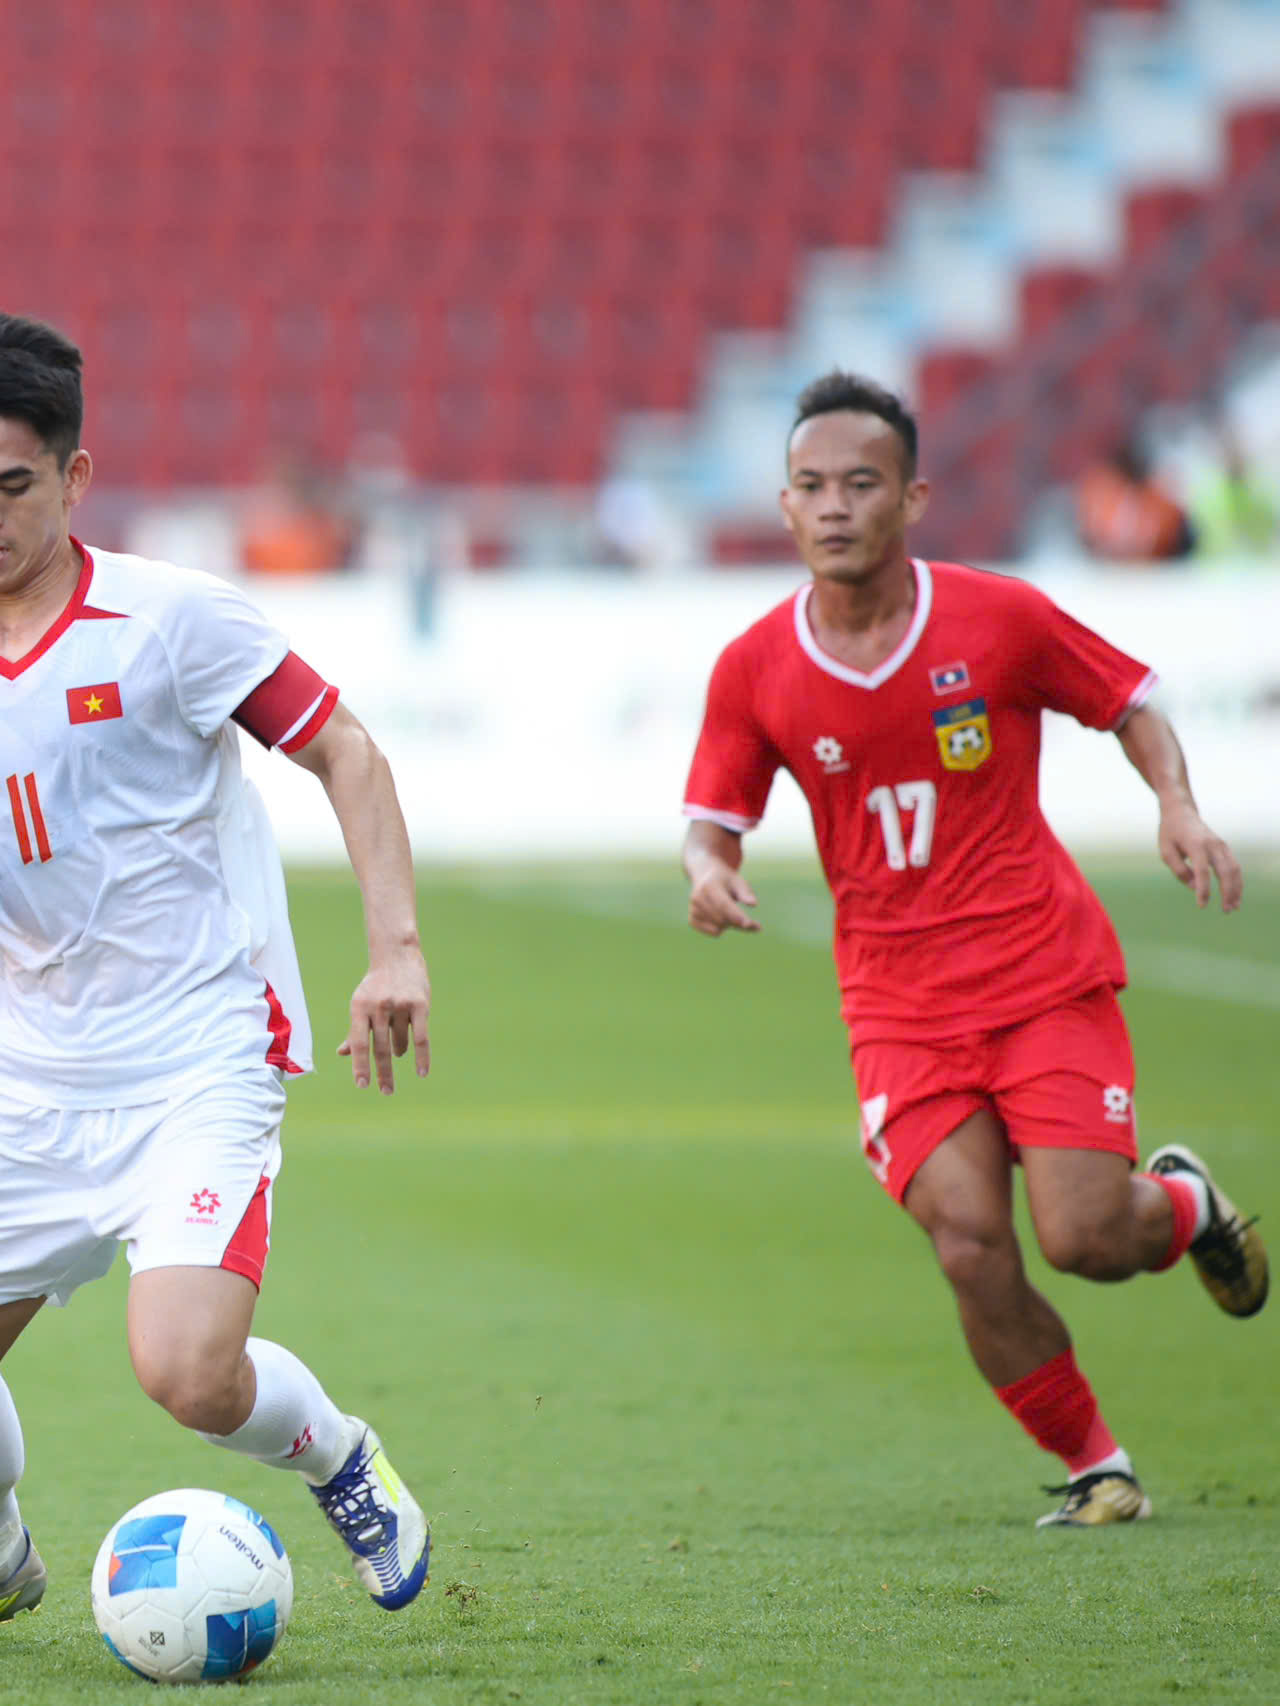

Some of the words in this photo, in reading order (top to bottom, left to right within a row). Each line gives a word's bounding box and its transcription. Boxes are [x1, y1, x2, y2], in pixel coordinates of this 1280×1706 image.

[6, 772, 53, 865] 11
[867, 780, 937, 871] 17
[219, 1526, 264, 1570] molten
